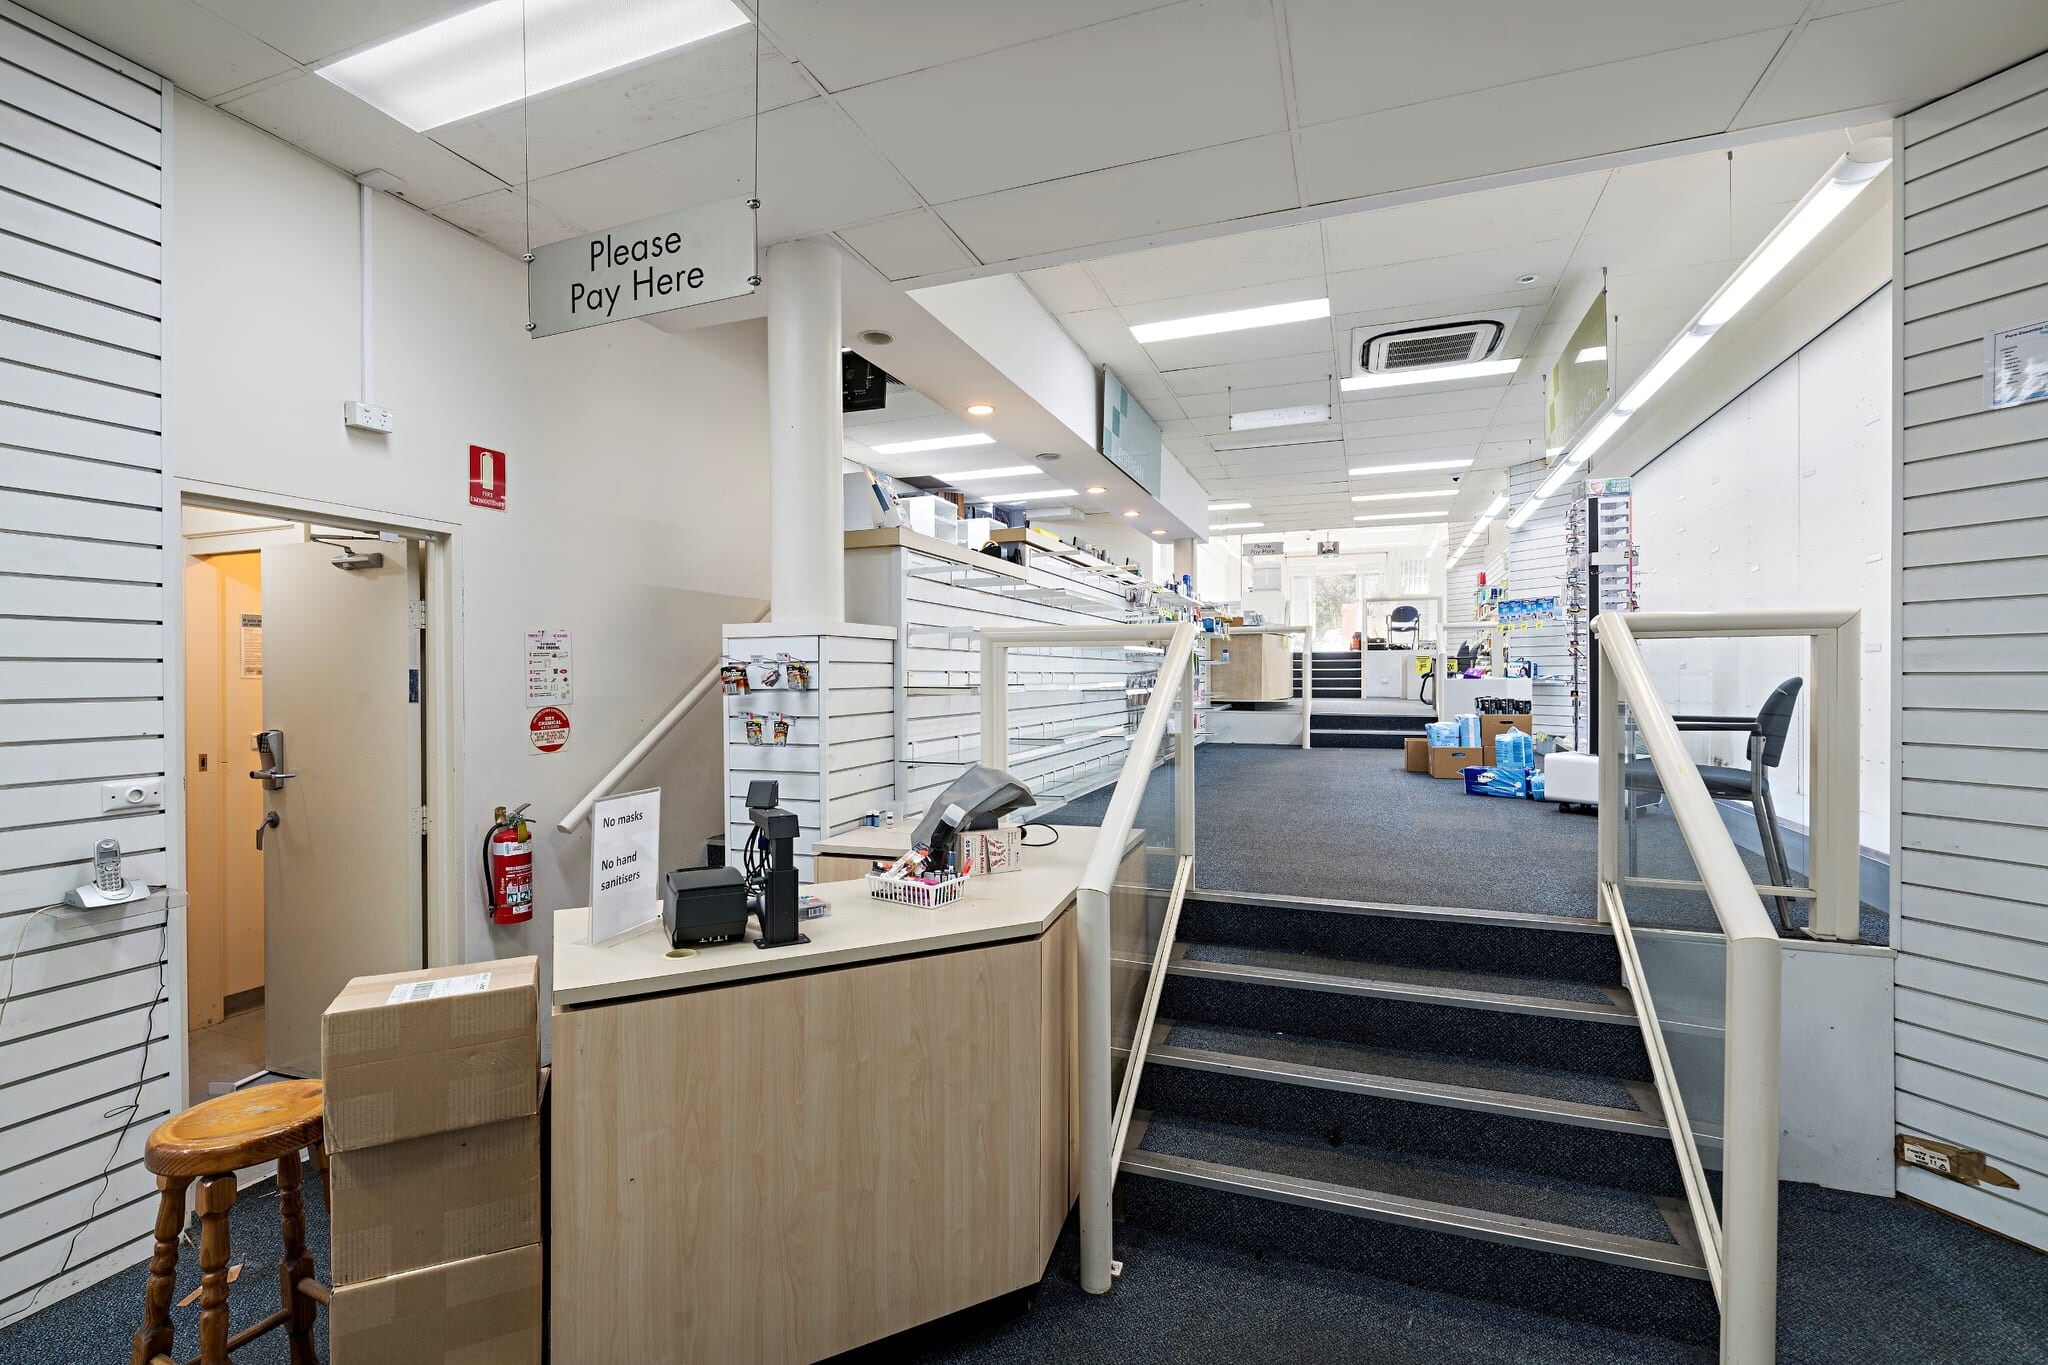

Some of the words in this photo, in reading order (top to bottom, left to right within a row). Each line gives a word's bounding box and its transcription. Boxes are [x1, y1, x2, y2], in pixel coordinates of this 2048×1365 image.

[590, 232, 682, 272] Please
[571, 282, 621, 317] Pay
[633, 266, 704, 301] Here
[603, 817, 616, 828] No
[617, 810, 644, 825] masks
[601, 860, 614, 871] No
[616, 851, 637, 867] hand
[600, 871, 641, 891] sanitisers
